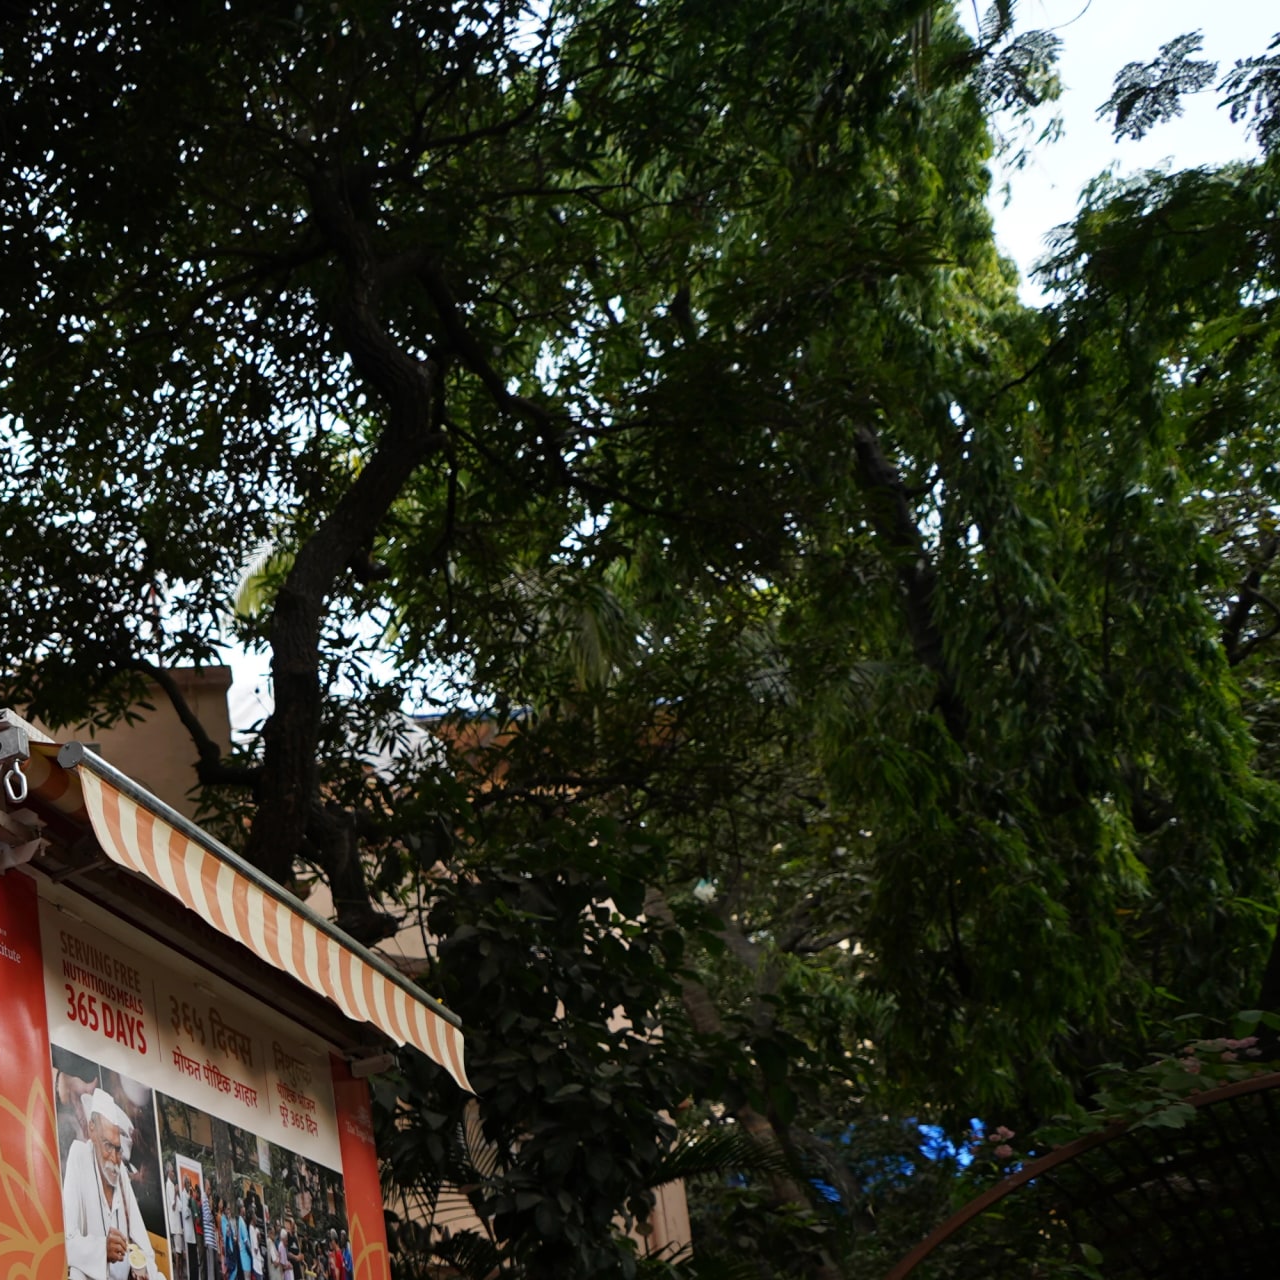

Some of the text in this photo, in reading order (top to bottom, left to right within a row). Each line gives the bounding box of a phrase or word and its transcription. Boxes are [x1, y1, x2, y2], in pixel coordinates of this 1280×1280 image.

[60, 931, 142, 993] SERVING FREE
[62, 959, 144, 1016] NUTRITIOUS MEALS
[65, 983, 147, 1055] 365 DAYS
[169, 995, 254, 1068] ३६५ दिवस
[172, 1045, 258, 1108] मोफत पौष्टिक आहार
[290, 1110, 305, 1131] 365
[305, 1114, 319, 1137] दिन
